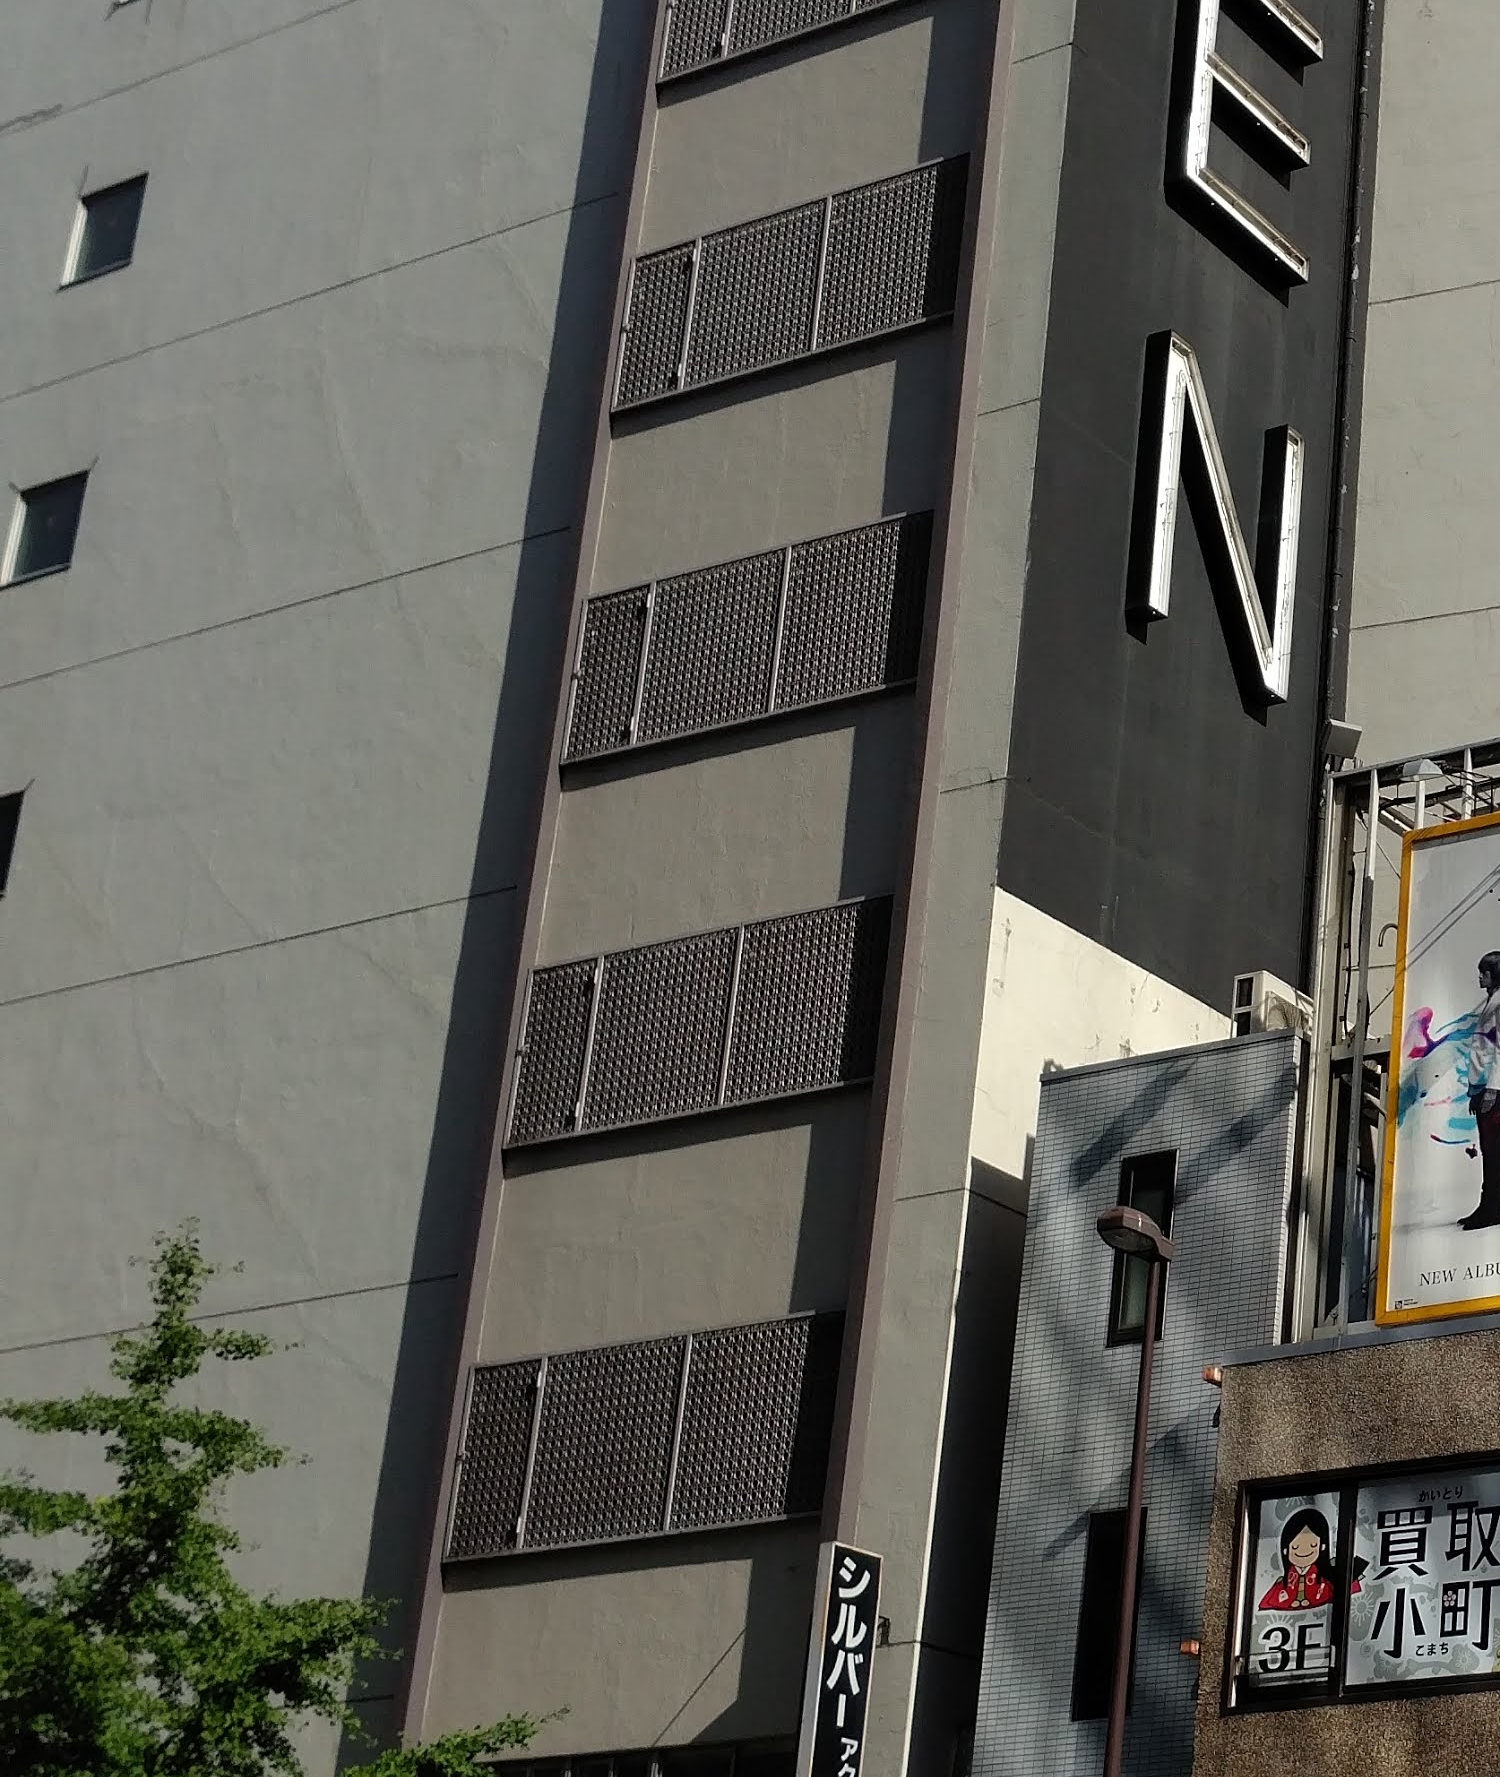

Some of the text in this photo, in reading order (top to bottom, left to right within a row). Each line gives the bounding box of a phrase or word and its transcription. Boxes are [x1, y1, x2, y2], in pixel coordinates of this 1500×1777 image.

[1419, 1268, 1458, 1287] NEW
[1418, 1485, 1464, 1503] かいとり
[826, 1555, 873, 1728] シルバー
[1415, 1642, 1450, 1658] こまち
